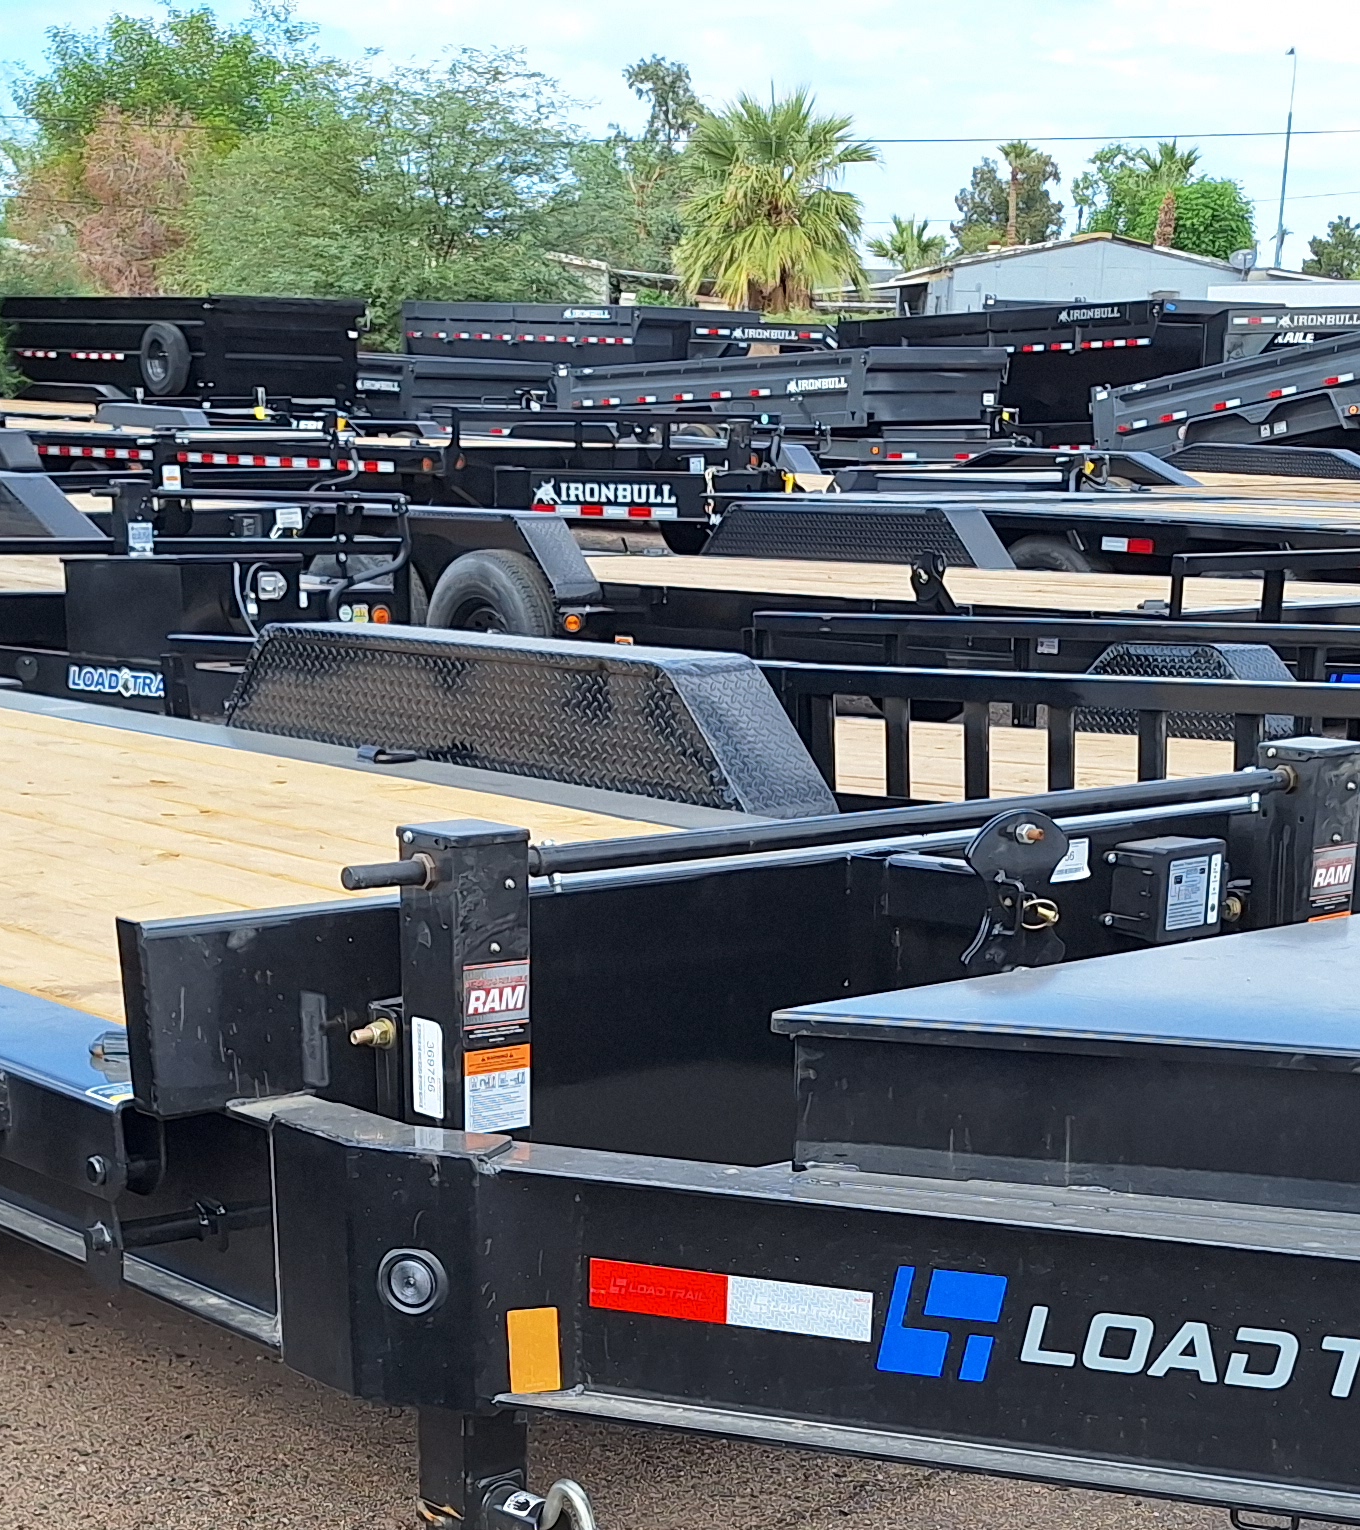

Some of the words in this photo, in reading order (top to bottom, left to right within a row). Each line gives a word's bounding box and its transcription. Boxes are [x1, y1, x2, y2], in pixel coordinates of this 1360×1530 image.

[1069, 306, 1121, 320] IRONBULL
[743, 328, 798, 340] IRONBULL
[797, 376, 848, 391] IRONBULL
[559, 482, 677, 504] IRONBULL
[68, 665, 120, 693] LOAD
[1313, 863, 1353, 888] RAM
[467, 985, 526, 1015] RAM
[426, 1040, 436, 1093] 369756
[1019, 1305, 1300, 1390] LOAD
